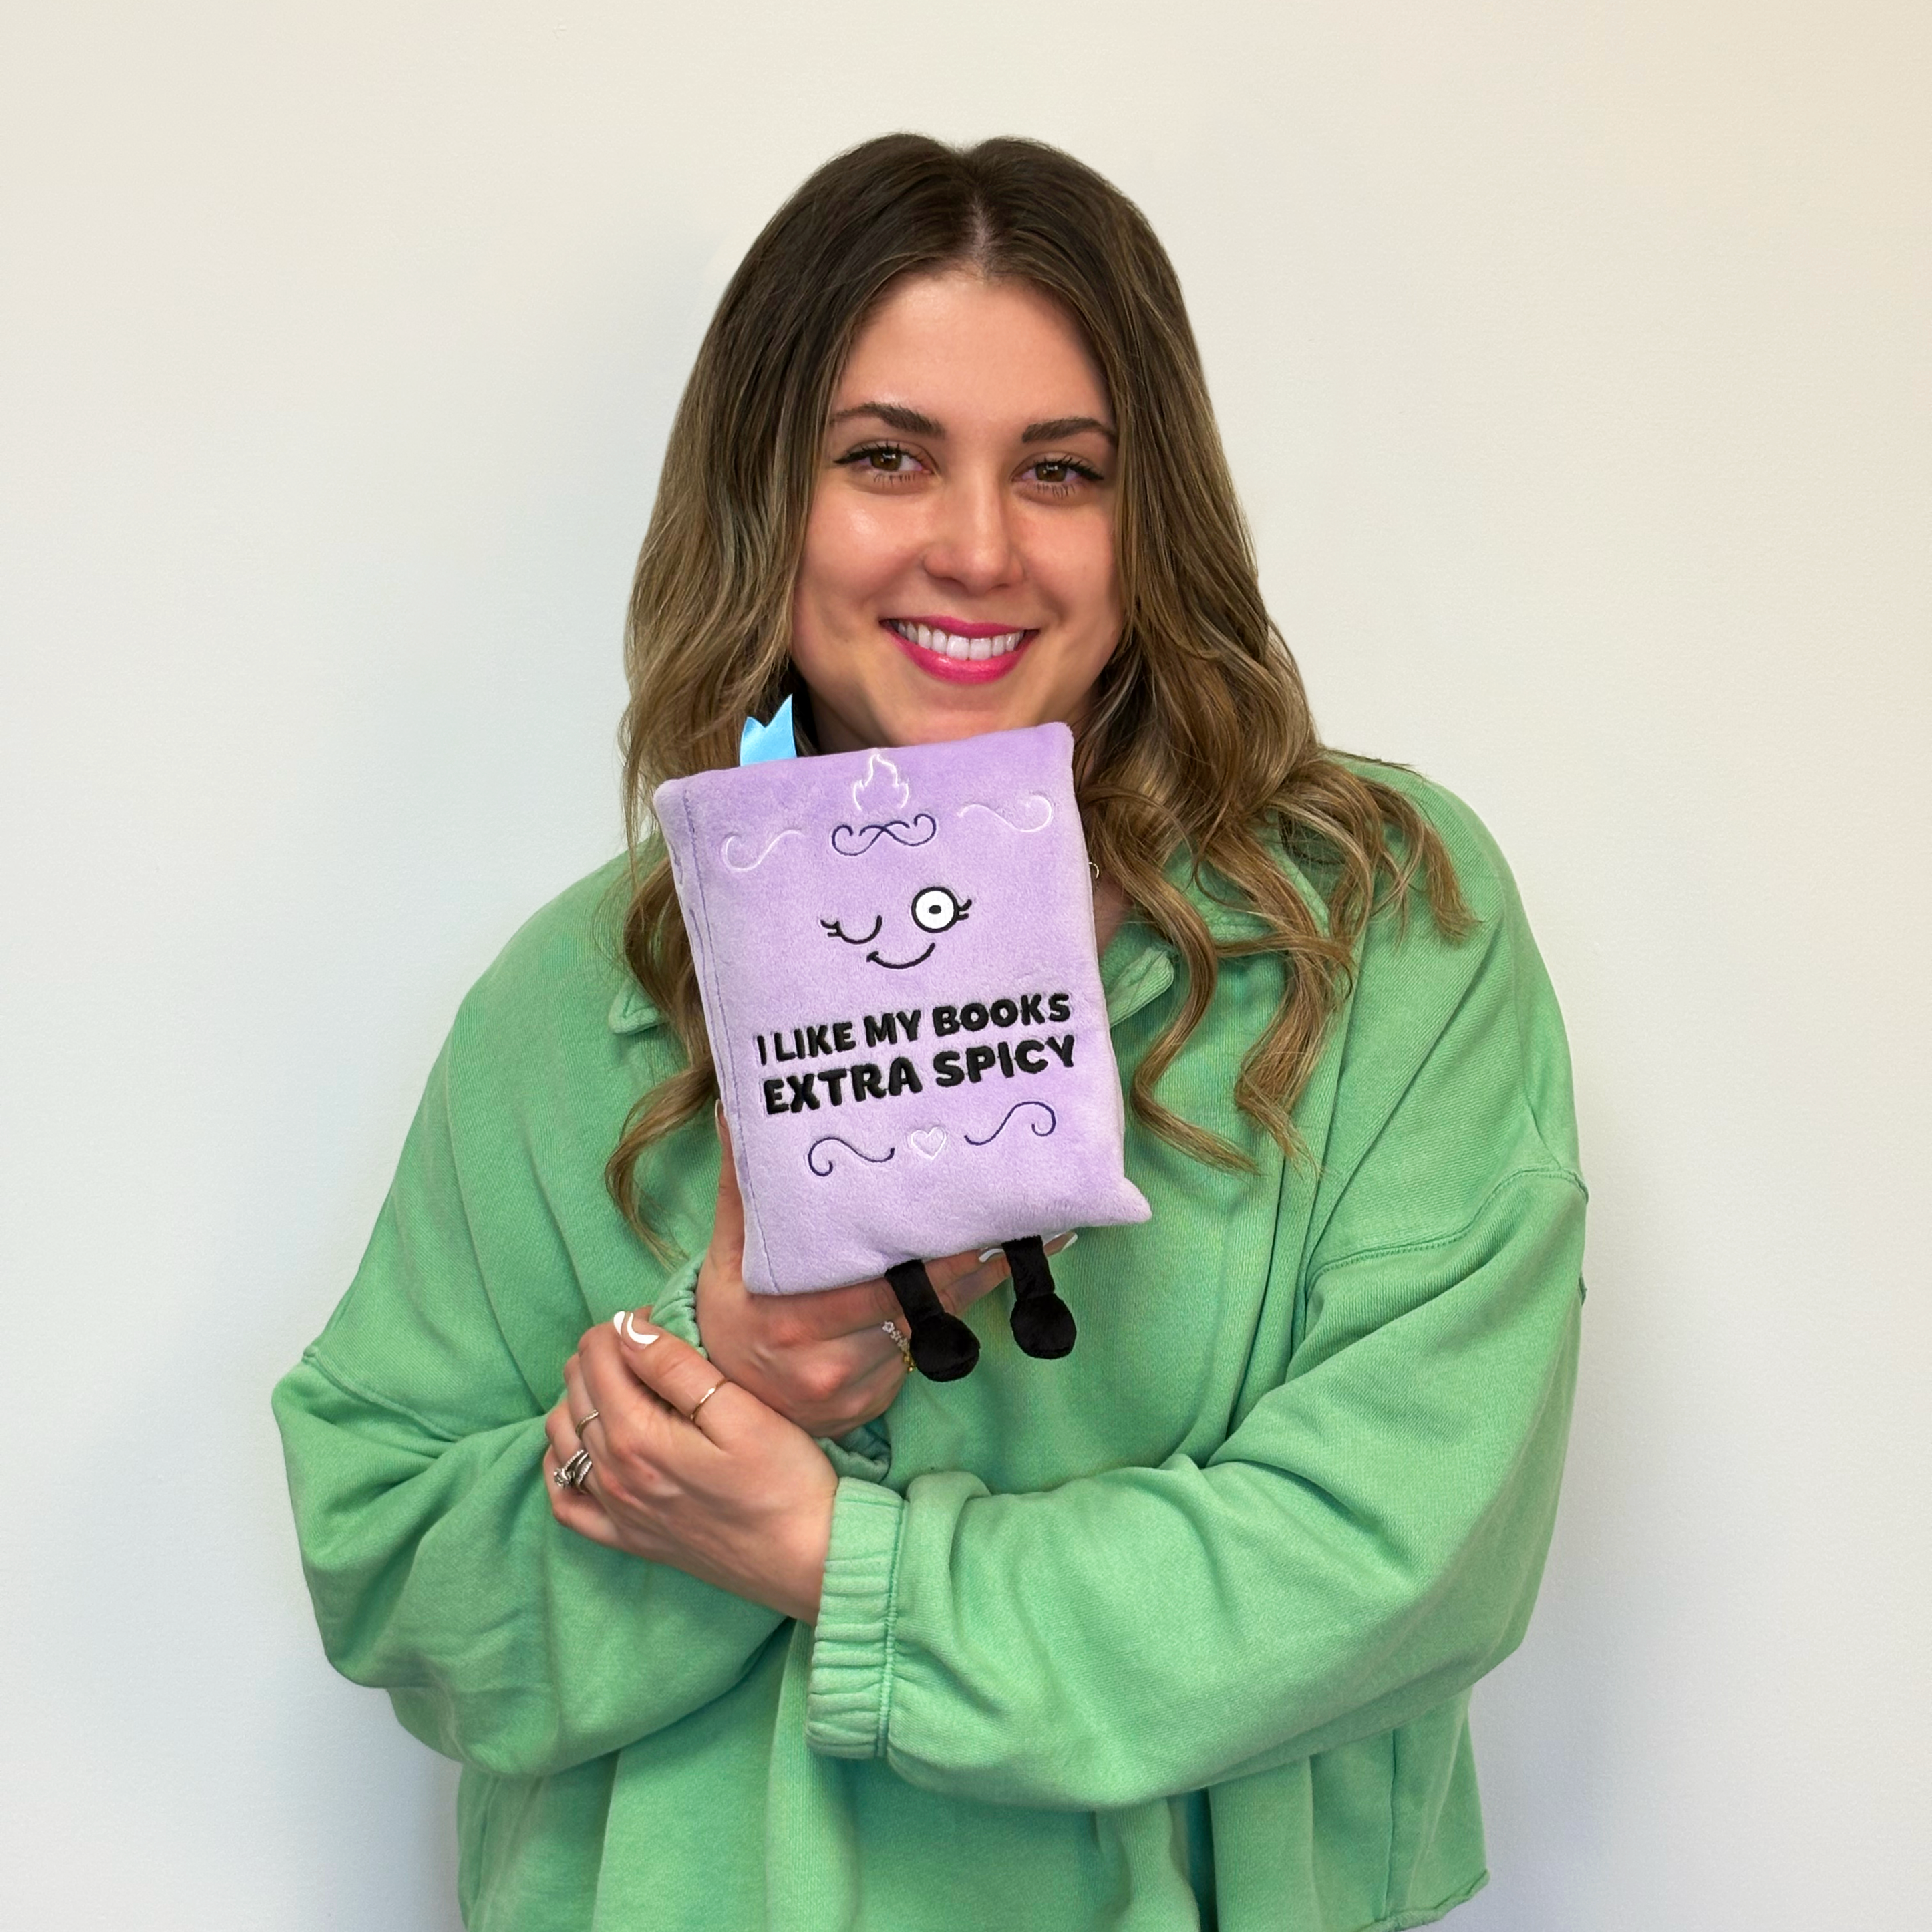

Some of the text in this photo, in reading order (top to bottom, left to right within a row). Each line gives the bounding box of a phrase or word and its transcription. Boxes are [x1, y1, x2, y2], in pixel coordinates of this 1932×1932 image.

[756, 993, 1071, 1066] I LIKE MY BOOKS
[763, 1034, 1075, 1115] EXTRA SPICY
